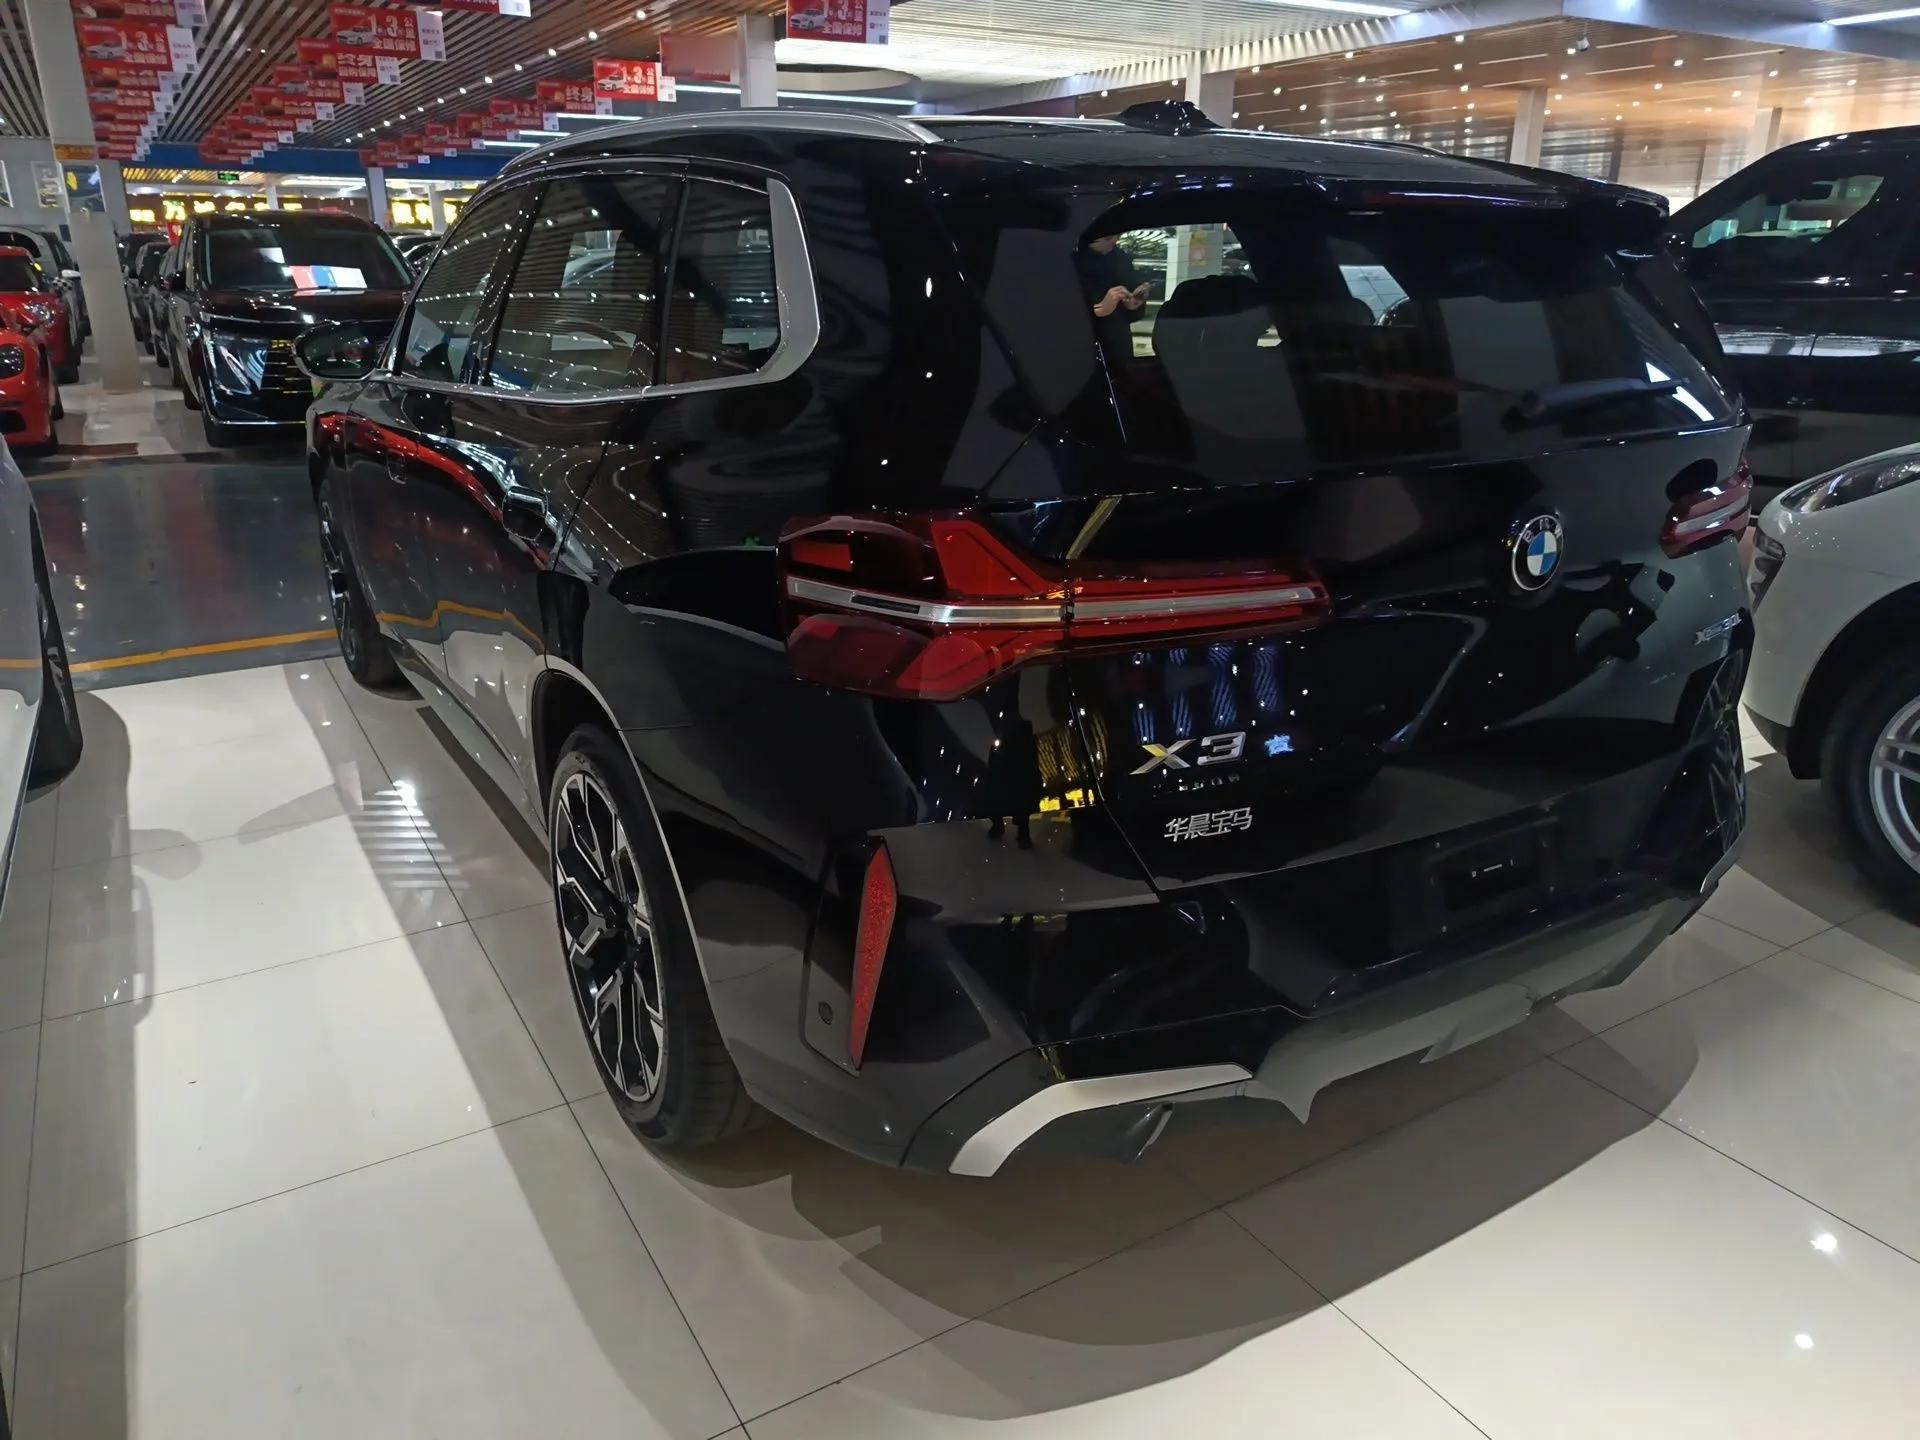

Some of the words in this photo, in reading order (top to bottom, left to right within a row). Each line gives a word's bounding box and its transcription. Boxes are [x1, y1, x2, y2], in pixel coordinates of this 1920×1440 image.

[1129, 731, 1247, 775] X3
[1164, 806, 1253, 842] 华晨宝马
